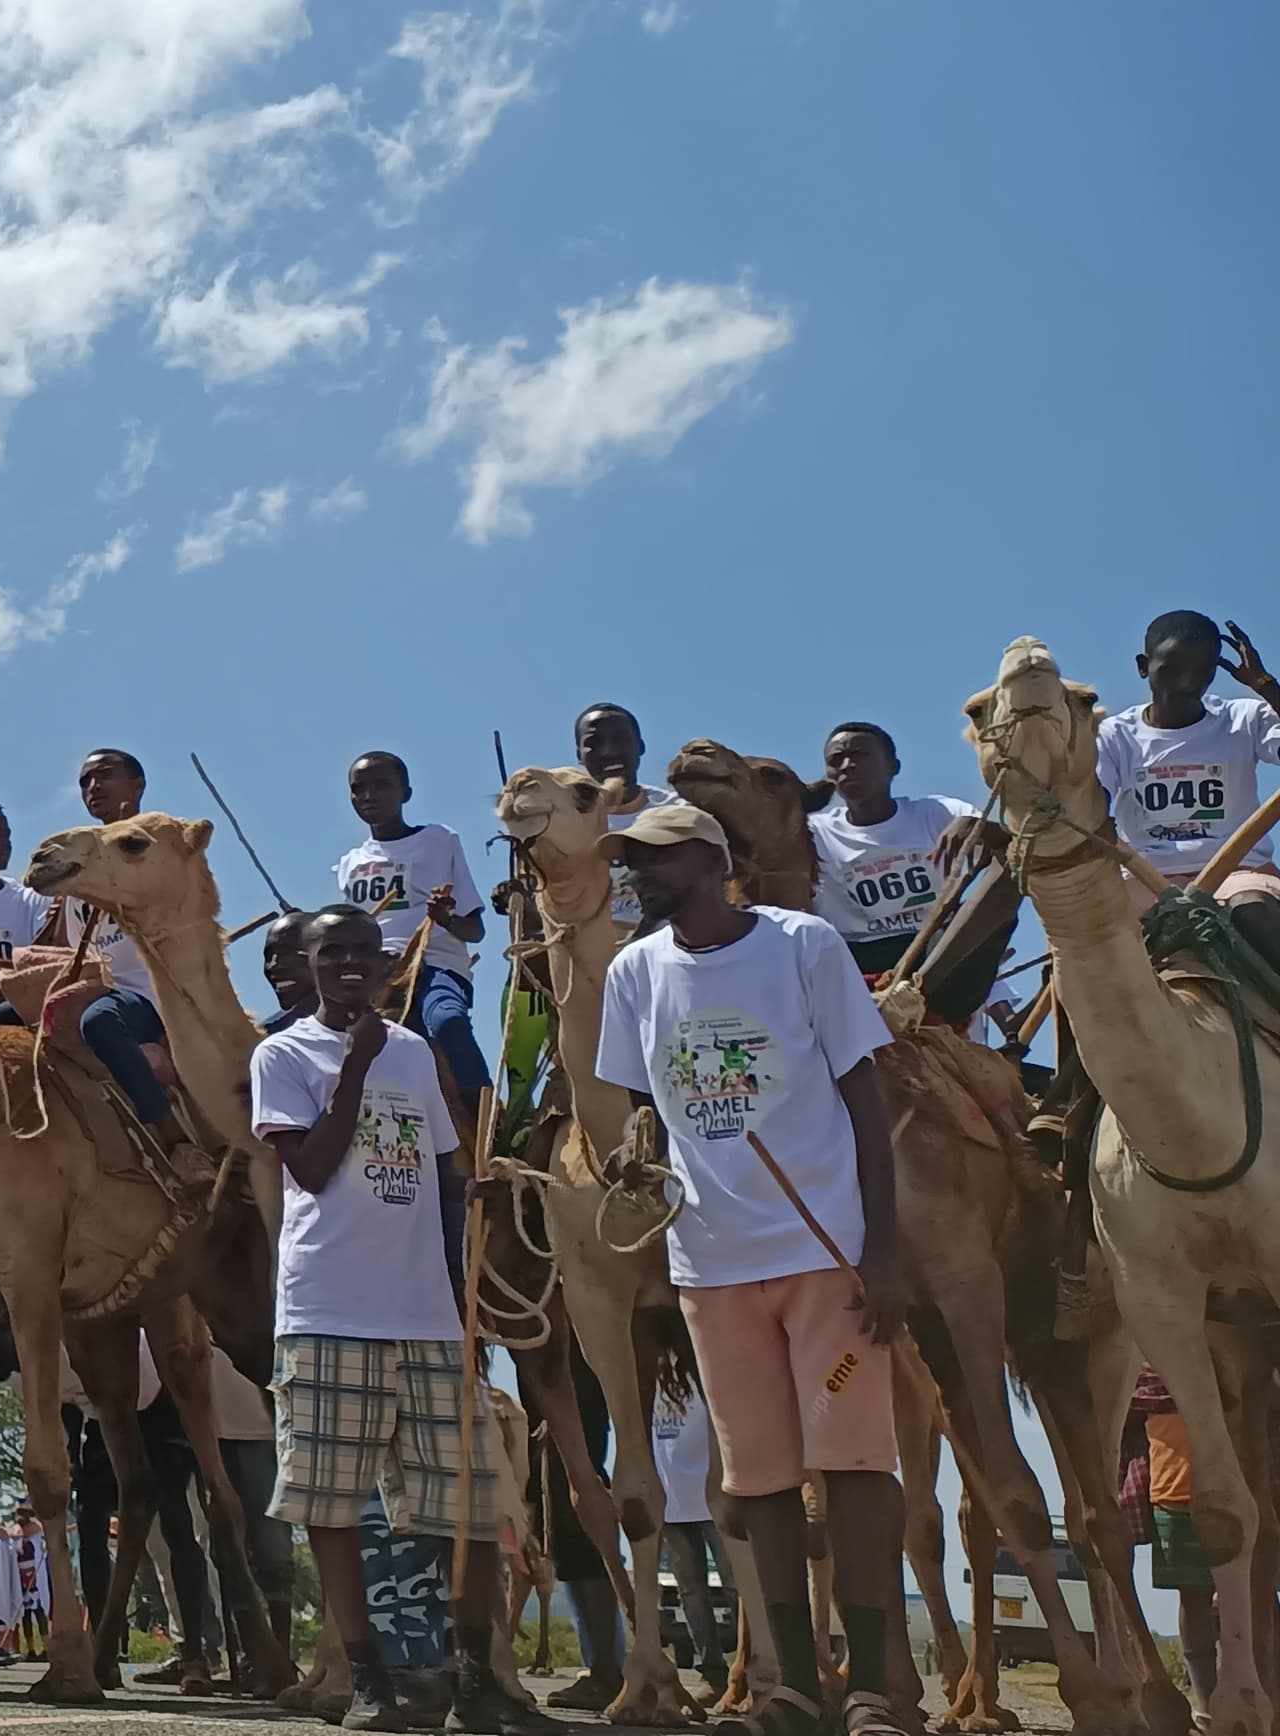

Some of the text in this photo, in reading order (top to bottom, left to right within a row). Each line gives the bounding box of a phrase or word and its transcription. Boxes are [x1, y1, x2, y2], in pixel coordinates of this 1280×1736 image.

[1144, 779, 1224, 812] 046
[352, 875, 406, 904] 064
[856, 866, 931, 907] 066
[685, 1096, 756, 1119] CAMEL
[364, 1164, 422, 1186] CAMEL
